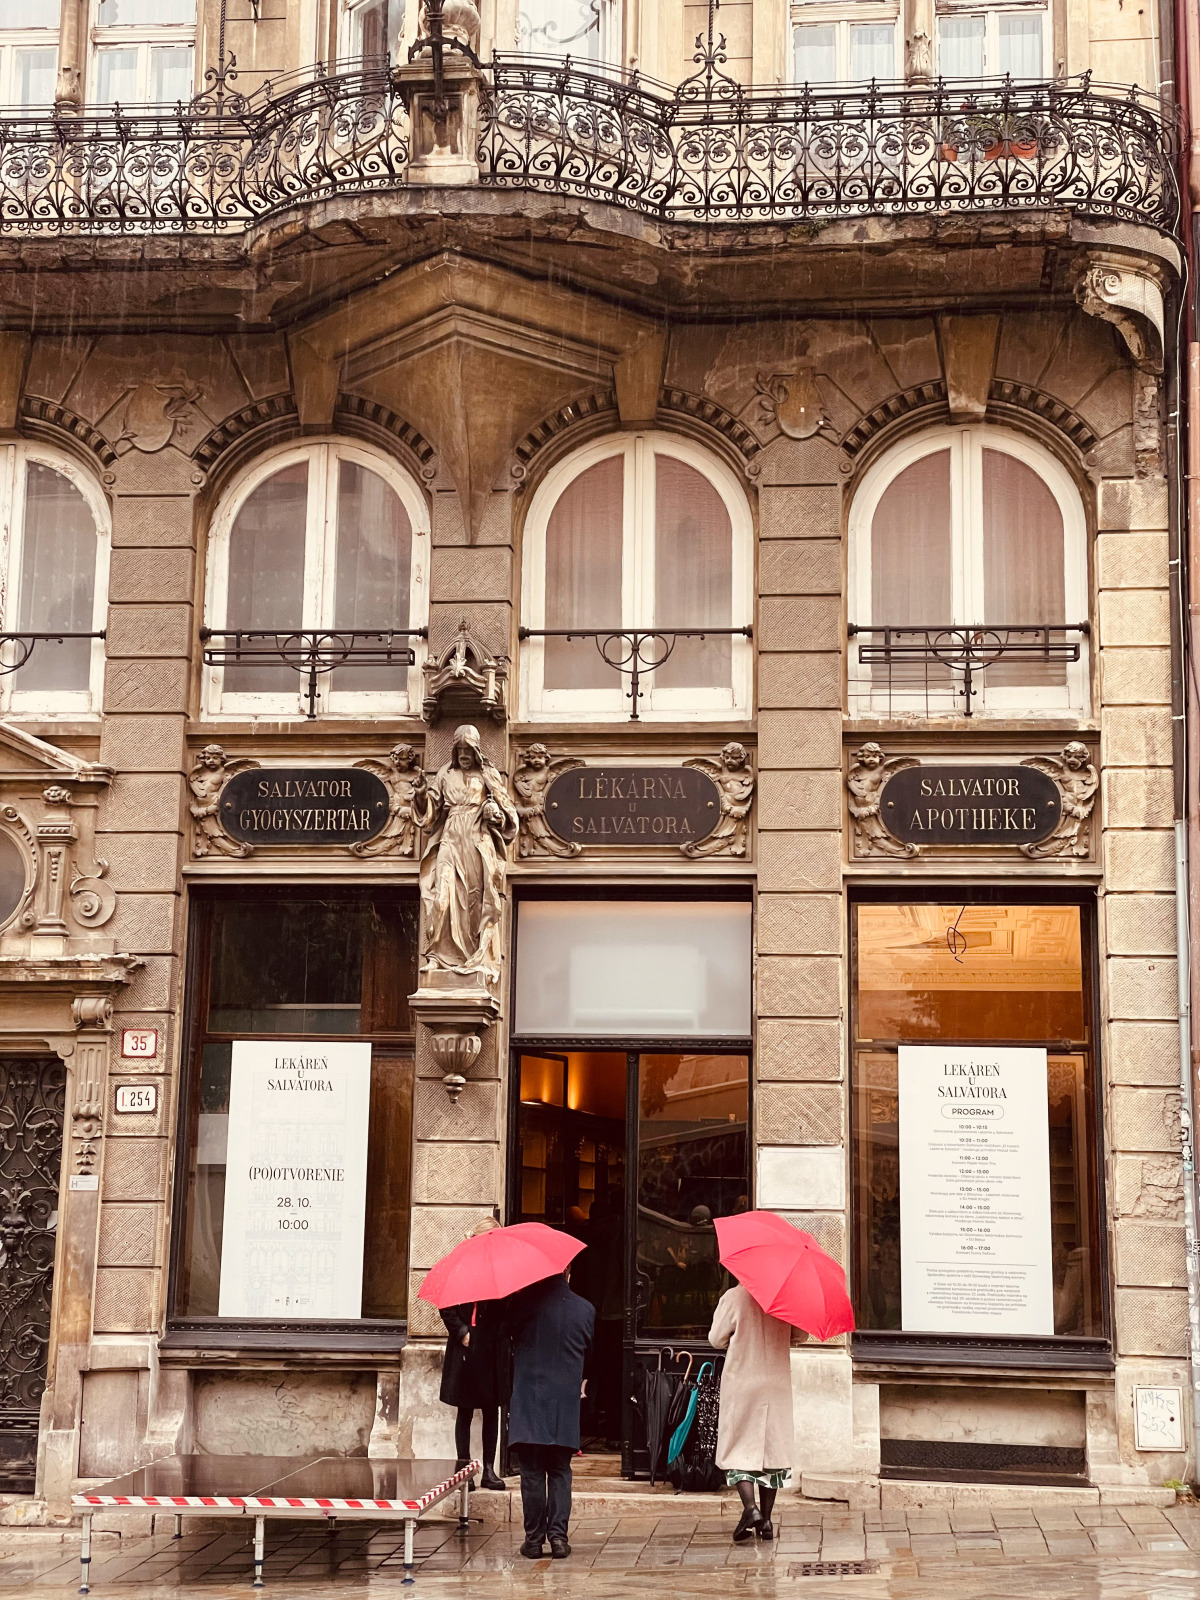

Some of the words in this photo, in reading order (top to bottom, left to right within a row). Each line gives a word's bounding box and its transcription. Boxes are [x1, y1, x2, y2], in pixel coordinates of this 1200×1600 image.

[257, 780, 352, 798] SALVATOR
[920, 778, 1021, 797] SALVATOR
[909, 807, 1036, 830] APOTHEKE
[131, 1035, 148, 1051] 35
[274, 1055, 329, 1070] LEKÁREŇ
[943, 1062, 1001, 1077] LEKÁREŇ
[297, 1070, 305, 1079] U
[968, 1076, 977, 1086] U
[267, 1079, 334, 1092] SALVATORA
[937, 1086, 1008, 1099] SALVATORA
[130, 1090, 150, 1107] 254
[951, 1107, 995, 1116] PROGRAM
[248, 1165, 345, 1182] (PO)OTVORENIE
[276, 1197, 294, 1208] 28.
[297, 1197, 312, 1208] 10.
[277, 1219, 309, 1230] 10:00
